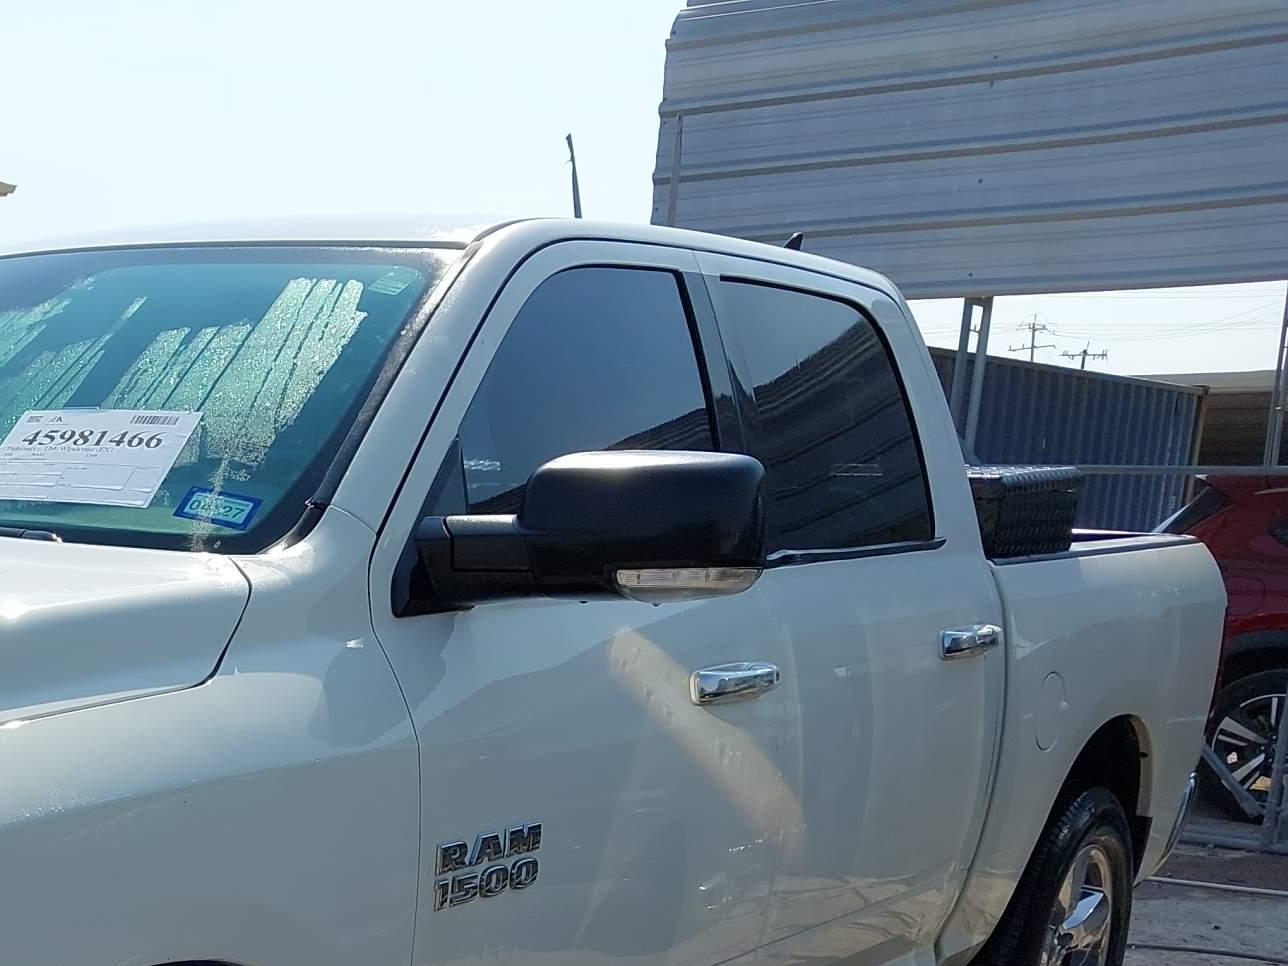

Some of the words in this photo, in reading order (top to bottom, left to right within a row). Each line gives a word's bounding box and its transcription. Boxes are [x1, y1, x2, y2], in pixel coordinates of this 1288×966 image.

[22, 429, 167, 449] 45981466
[222, 505, 246, 519] 27
[435, 821, 542, 876] RAM
[433, 857, 539, 912] 1500
